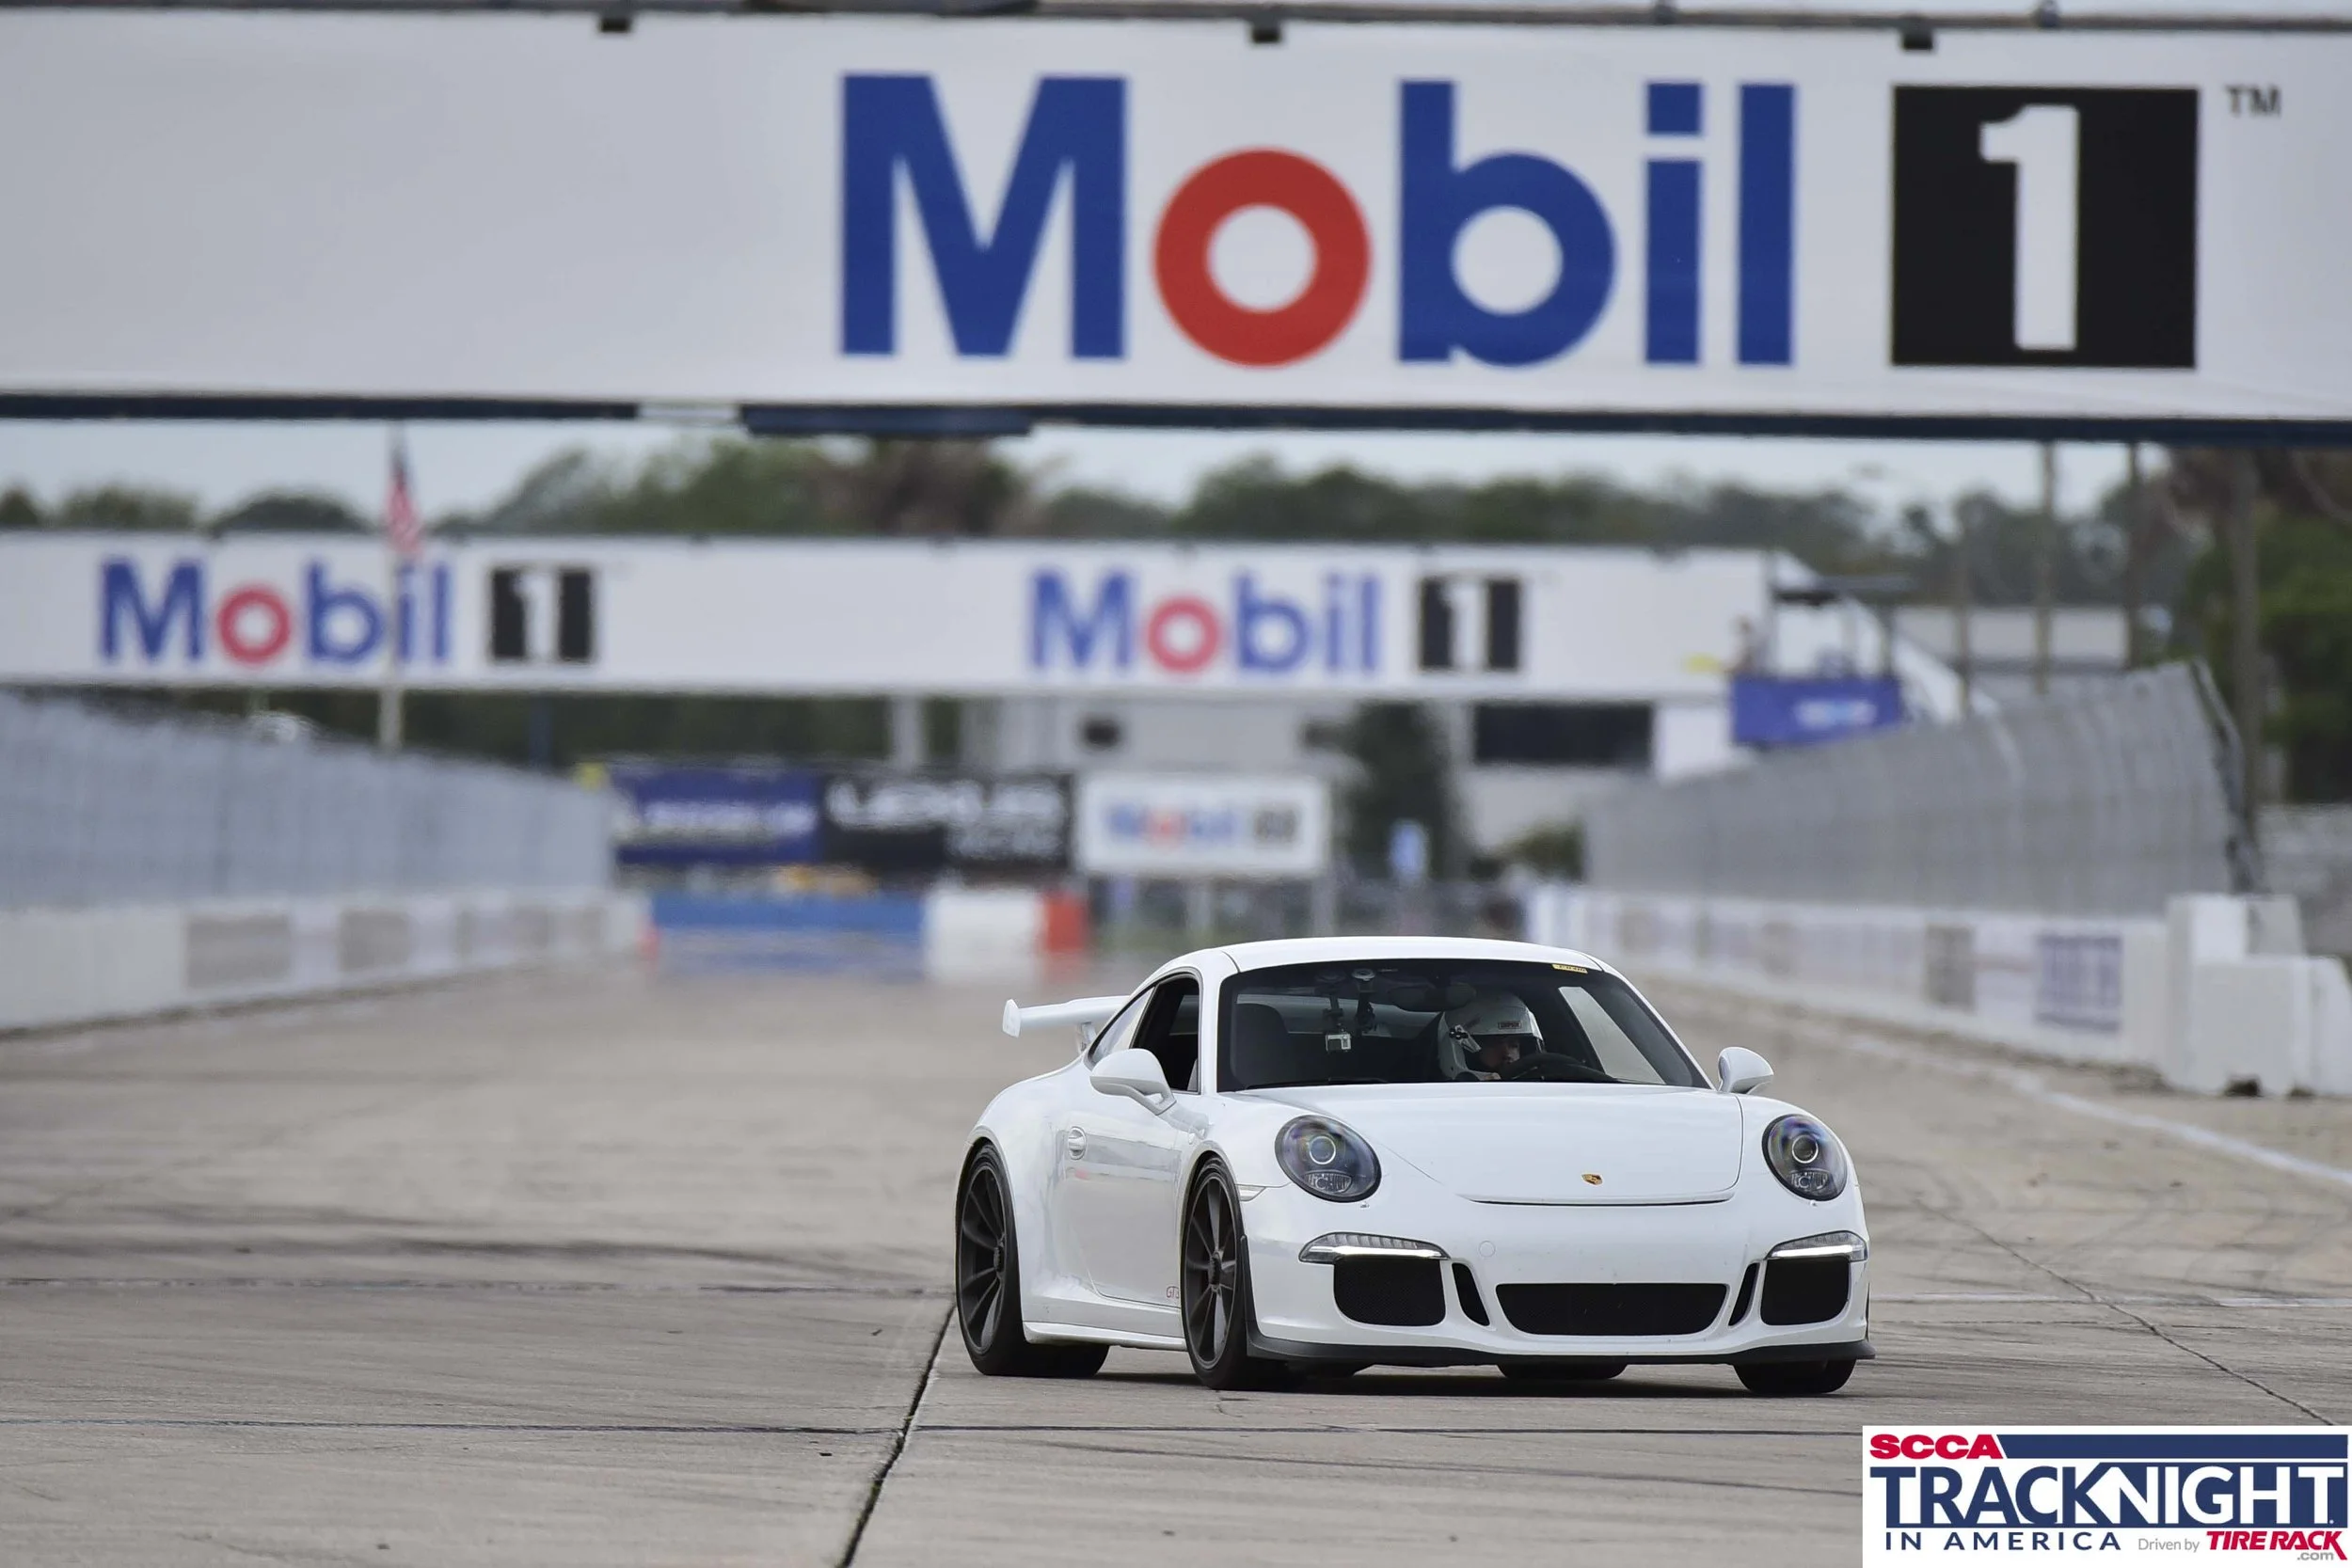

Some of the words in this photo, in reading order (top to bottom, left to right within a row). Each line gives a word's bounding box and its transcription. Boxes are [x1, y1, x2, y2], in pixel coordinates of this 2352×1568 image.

[839, 74, 1796, 368] Mobil
[1979, 104, 2078, 350] 1
[2225, 85, 2281, 117] TM
[99, 558, 453, 665] Mobil
[1029, 569, 1382, 675] Mobil
